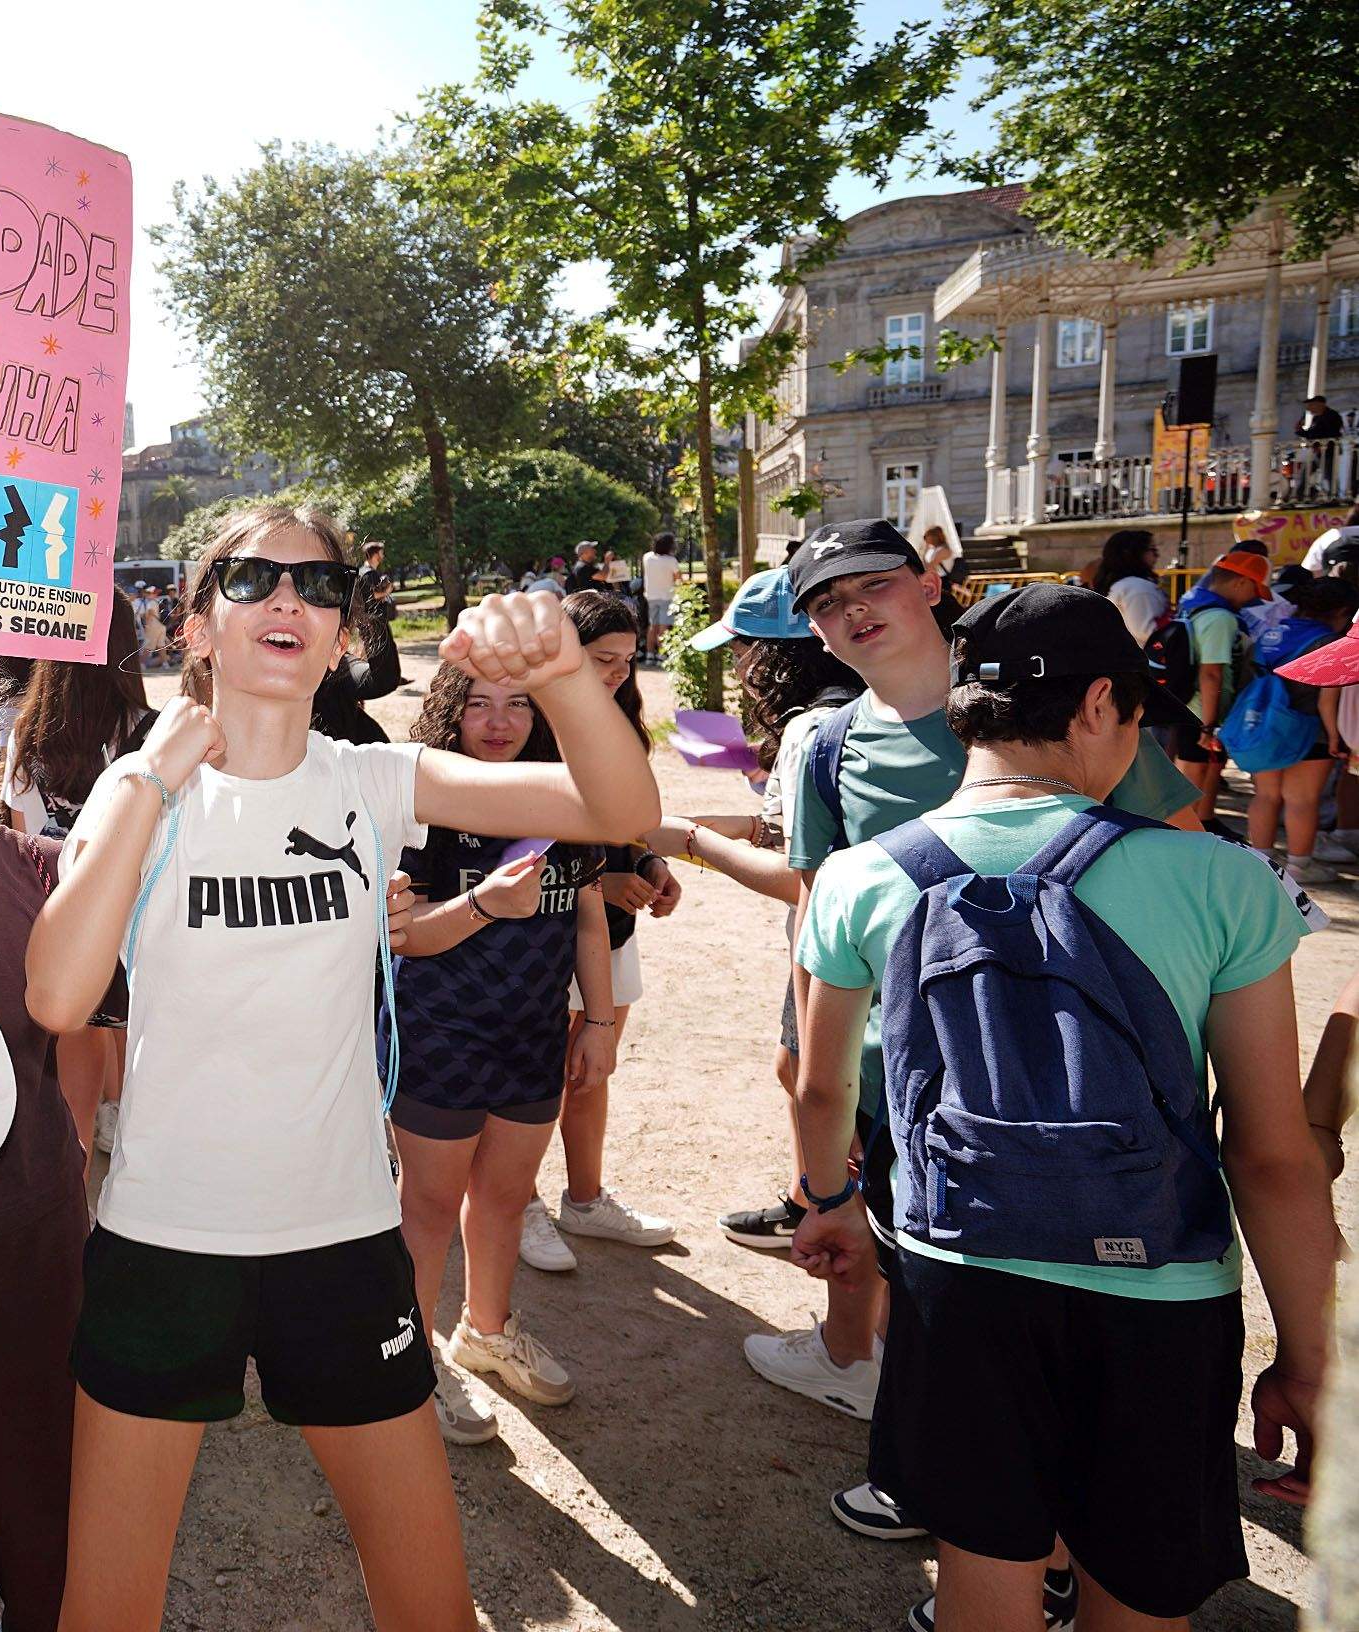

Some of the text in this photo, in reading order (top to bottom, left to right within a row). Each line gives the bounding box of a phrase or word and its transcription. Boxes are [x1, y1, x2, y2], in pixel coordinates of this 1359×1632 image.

[29, 585, 45, 599] DE
[48, 588, 92, 606] ENSINO
[9, 615, 88, 642] SEOANE
[187, 868, 350, 929] PUMA
[539, 887, 575, 914] TTER
[1104, 1241, 1135, 1253] NYC
[380, 1325, 414, 1361] PUMA
